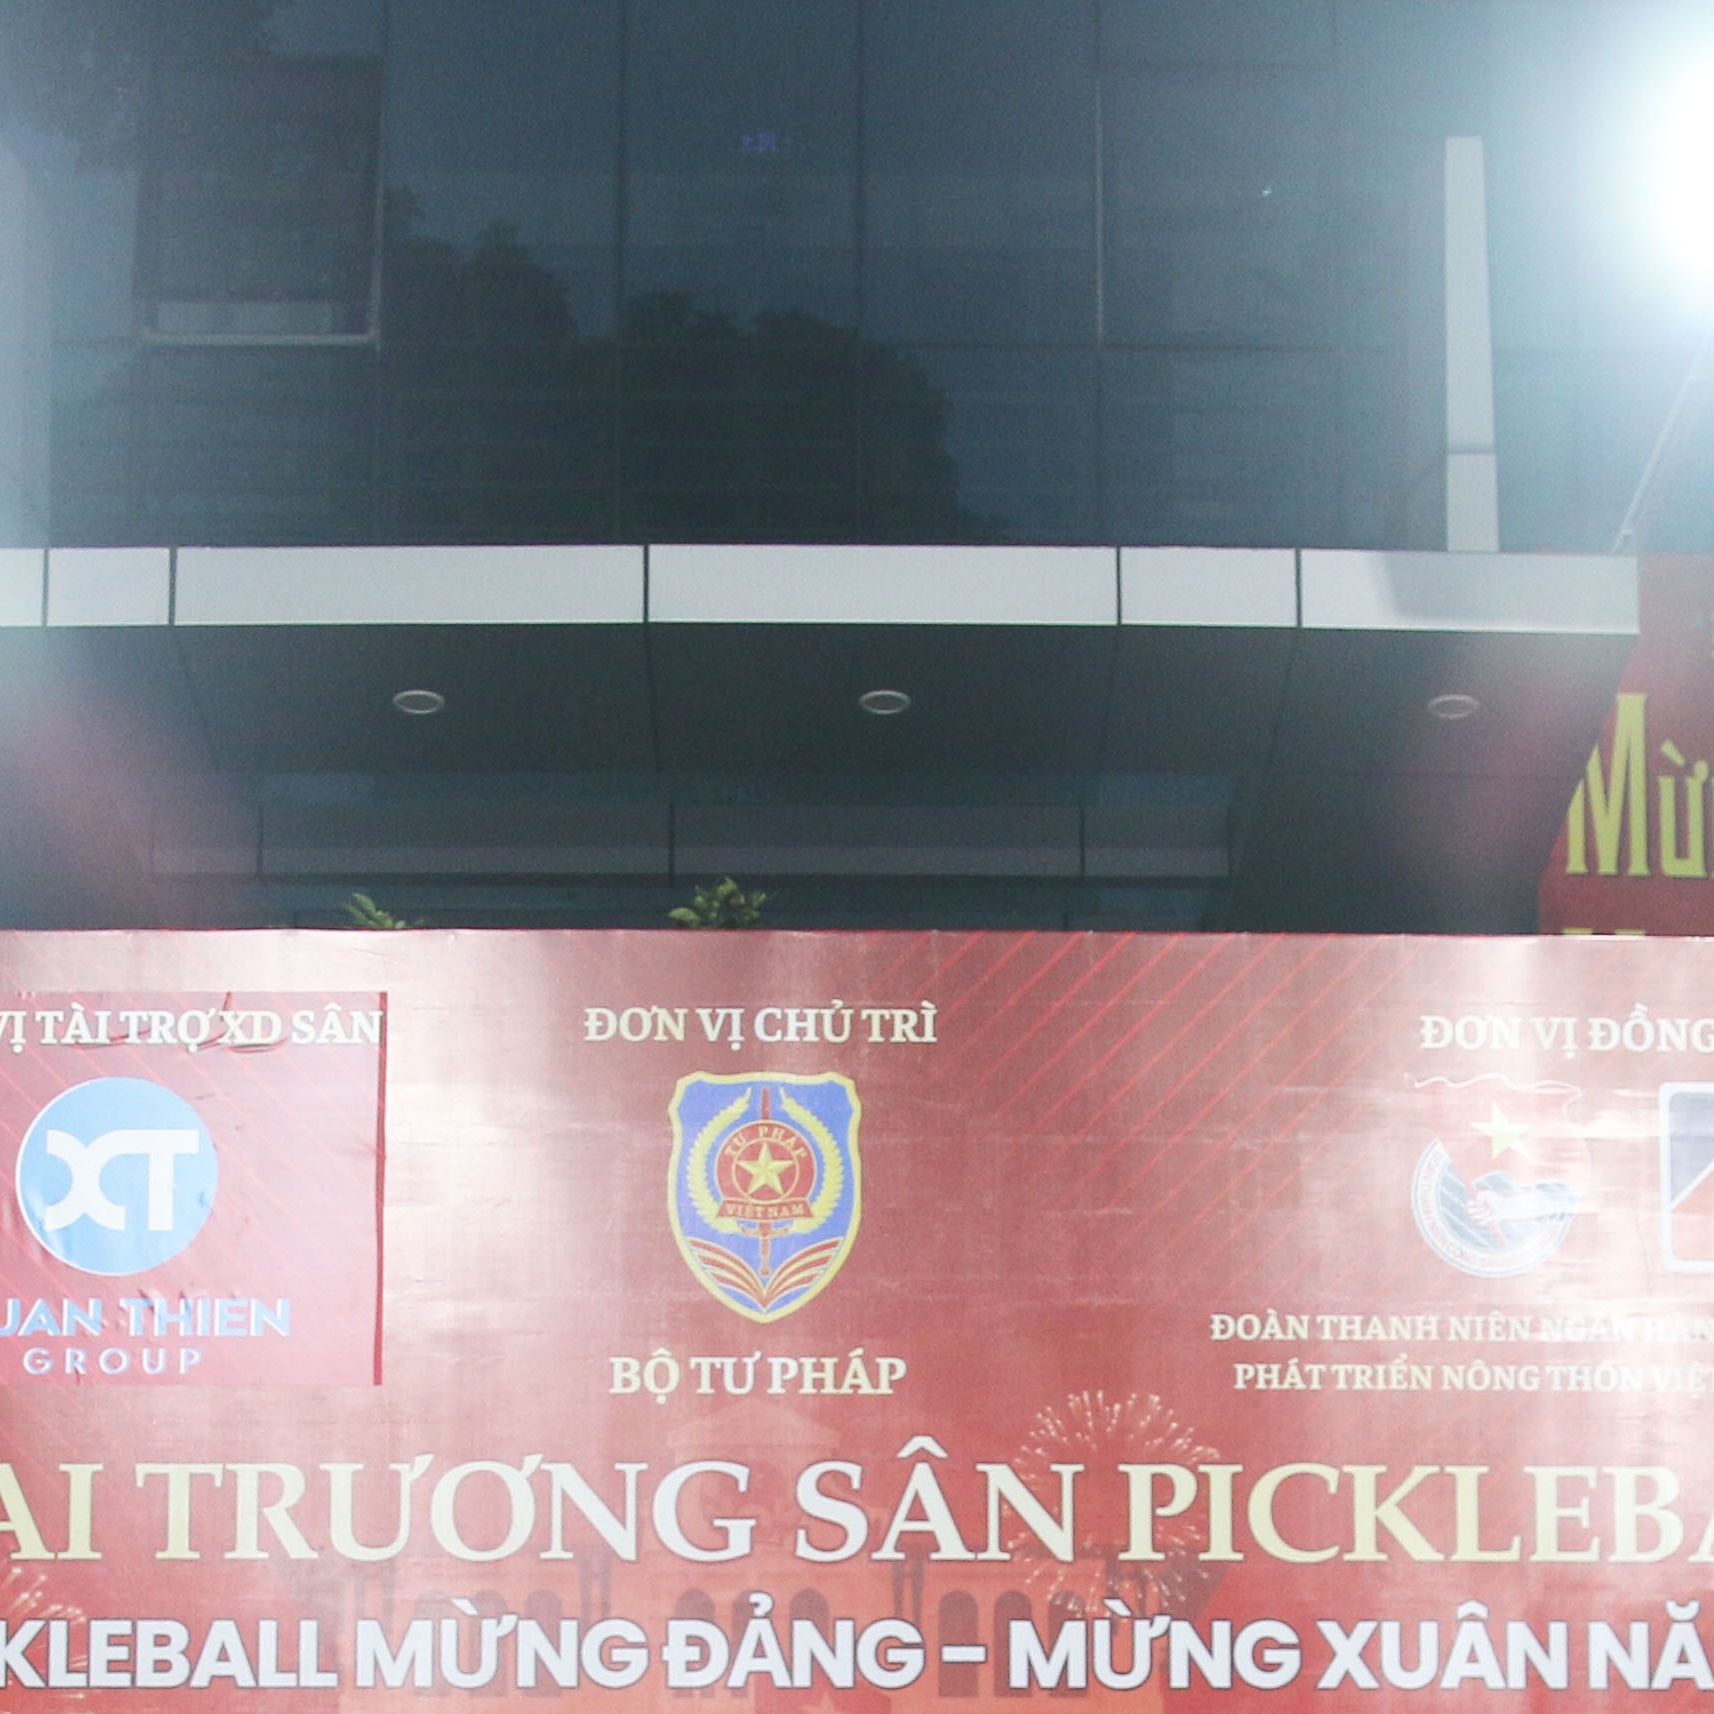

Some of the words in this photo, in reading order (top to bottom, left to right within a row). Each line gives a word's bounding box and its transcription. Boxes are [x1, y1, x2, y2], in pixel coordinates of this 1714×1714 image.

[35, 1002, 111, 1045] TÀI
[120, 1007, 216, 1053] TRỢ
[220, 1009, 283, 1046] XD
[291, 1003, 385, 1045] SÂN
[584, 1004, 688, 1043] ĐƠN
[695, 1007, 745, 1051] VỊ
[753, 999, 855, 1044] CHỦ
[861, 1000, 939, 1043] TRÌ
[1419, 1013, 1521, 1050] ĐƠN
[1530, 1016, 1578, 1059] VỊ
[119, 1297, 292, 1338] THIEN
[1210, 1308, 1310, 1342] ĐOÀN
[1316, 1313, 1438, 1343] THANH
[1448, 1310, 1533, 1344] NIÊN
[22, 1346, 204, 1376] GROUP
[608, 1347, 680, 1405] BỘ
[689, 1350, 763, 1395] TƯ
[766, 1348, 908, 1395] PHÁP
[1232, 1358, 1328, 1391] PHÁT
[1331, 1352, 1433, 1392] TRIỂN
[1441, 1360, 1540, 1392] NÔNG
[1547, 1361, 1644, 1393] THÔN
[134, 1452, 756, 1565] TRƯƠNG
[793, 1435, 1084, 1565] SÂN
[354, 1596, 650, 1692] MỪNG
[660, 1590, 927, 1692] ĐẢNG
[1007, 1597, 1303, 1693] MỪNG
[1316, 1602, 1570, 1693] XUÂN
